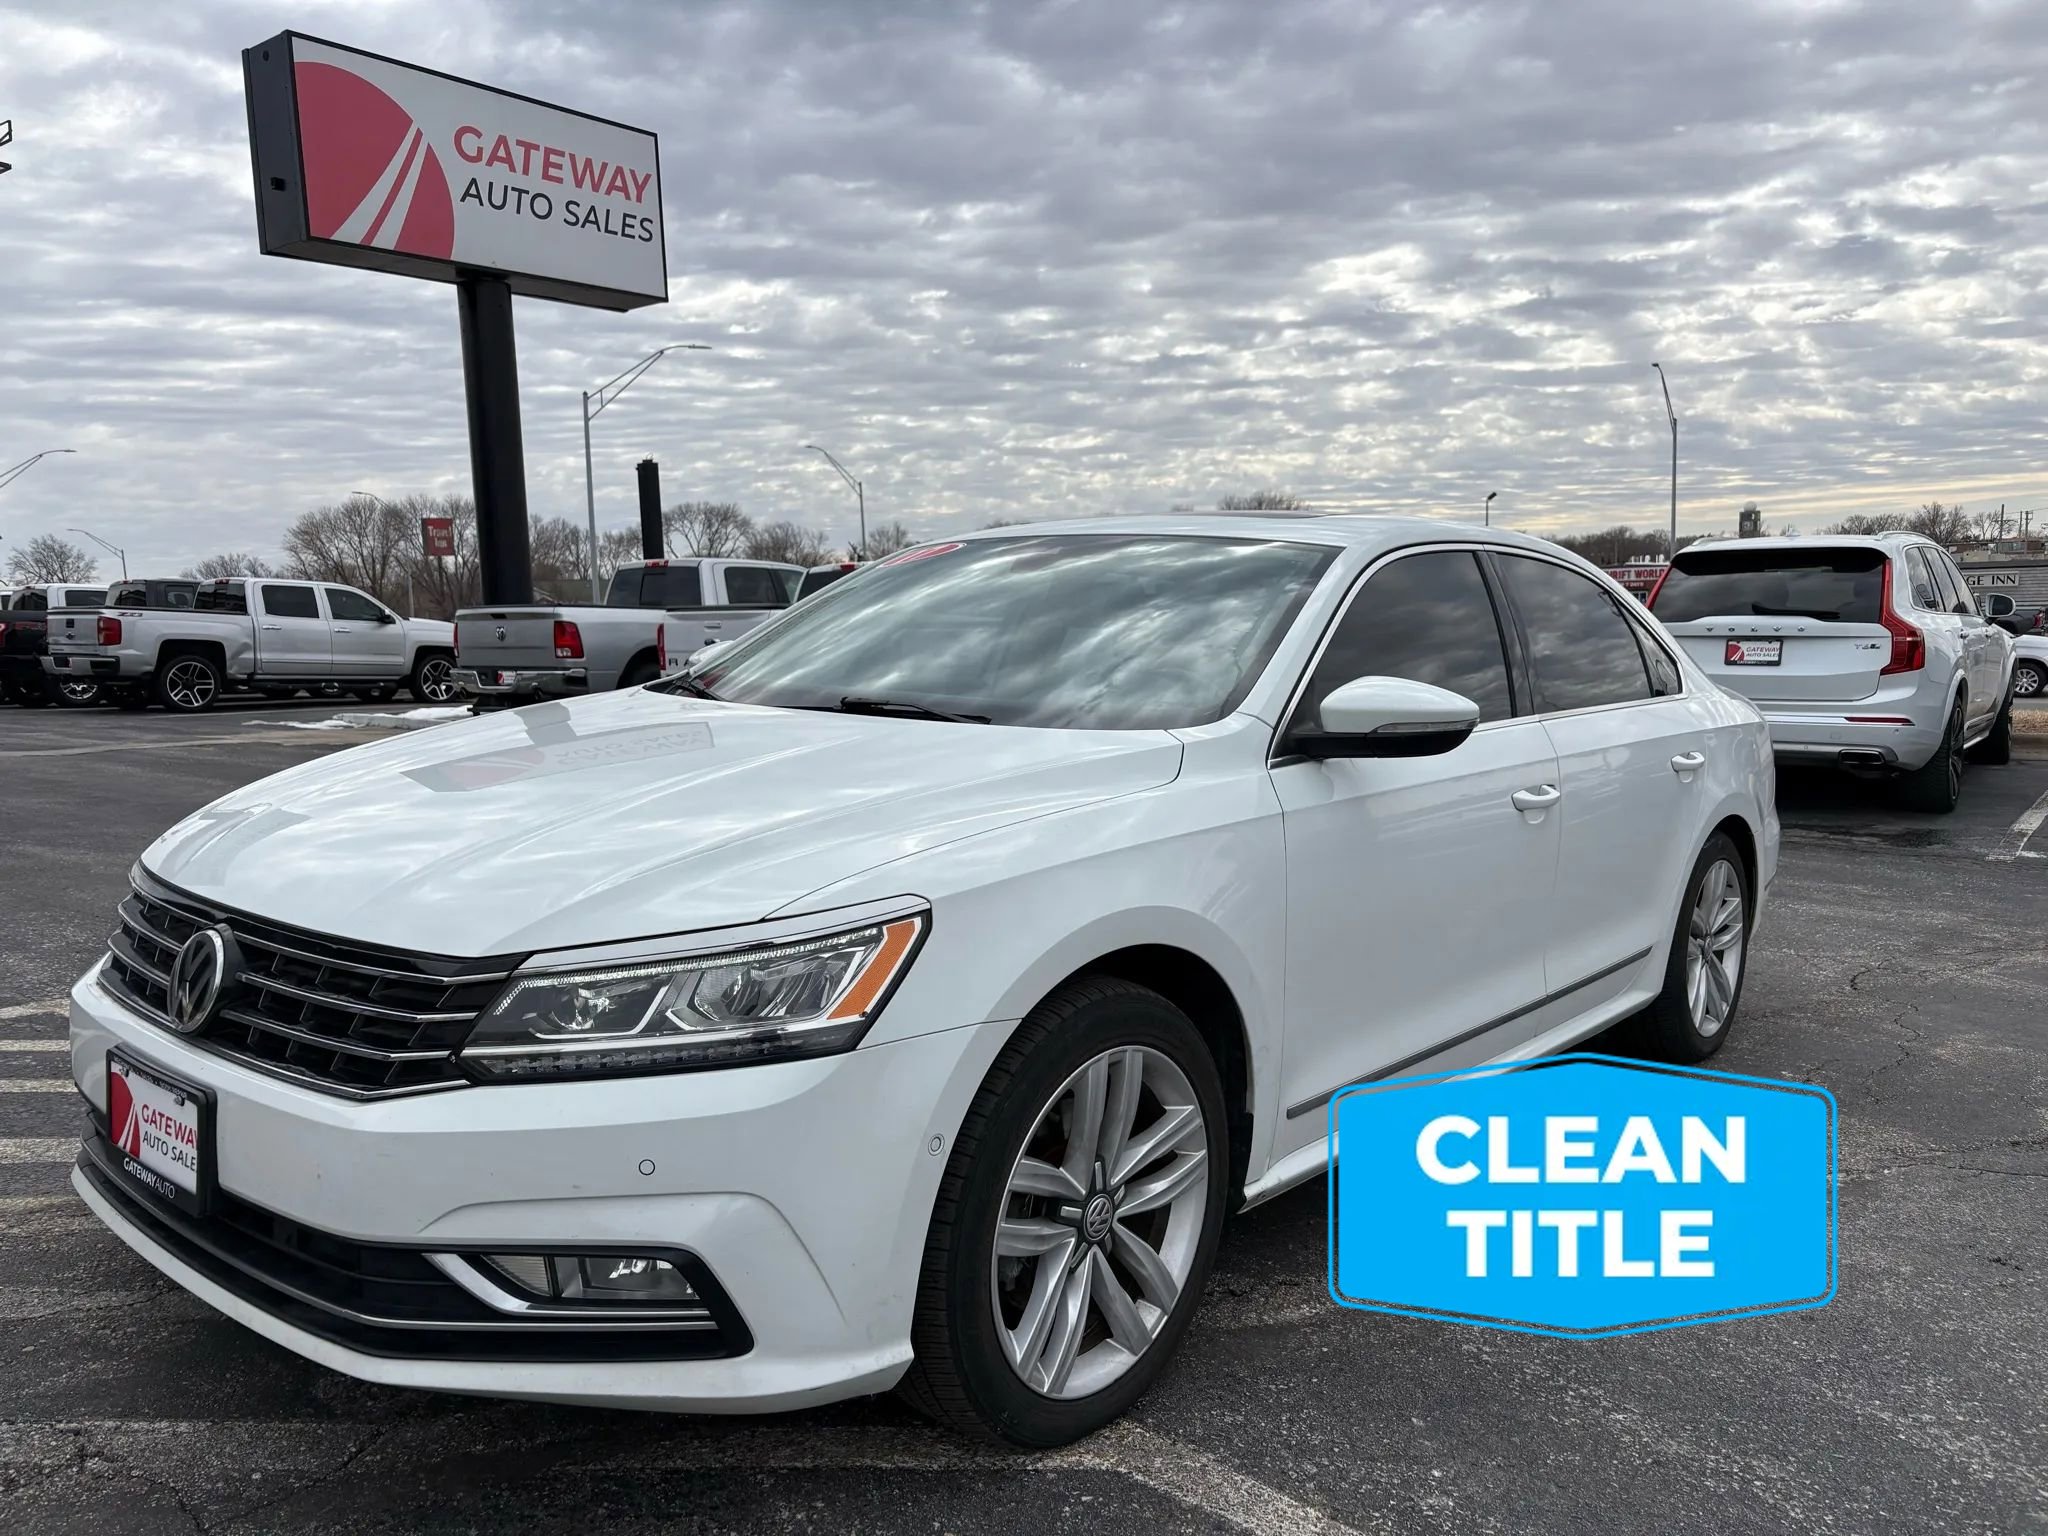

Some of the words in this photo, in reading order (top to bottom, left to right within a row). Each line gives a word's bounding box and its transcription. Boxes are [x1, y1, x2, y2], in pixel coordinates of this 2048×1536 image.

[453, 125, 653, 204] GATEWAY
[459, 177, 553, 220] AUTO
[563, 200, 654, 243] SALES
[1607, 569, 1632, 580] HRIFT
[1634, 569, 1665, 578] WORLD
[1991, 574, 2016, 585] INN
[142, 1131, 169, 1157] AUTO
[170, 1146, 198, 1172] SALE
